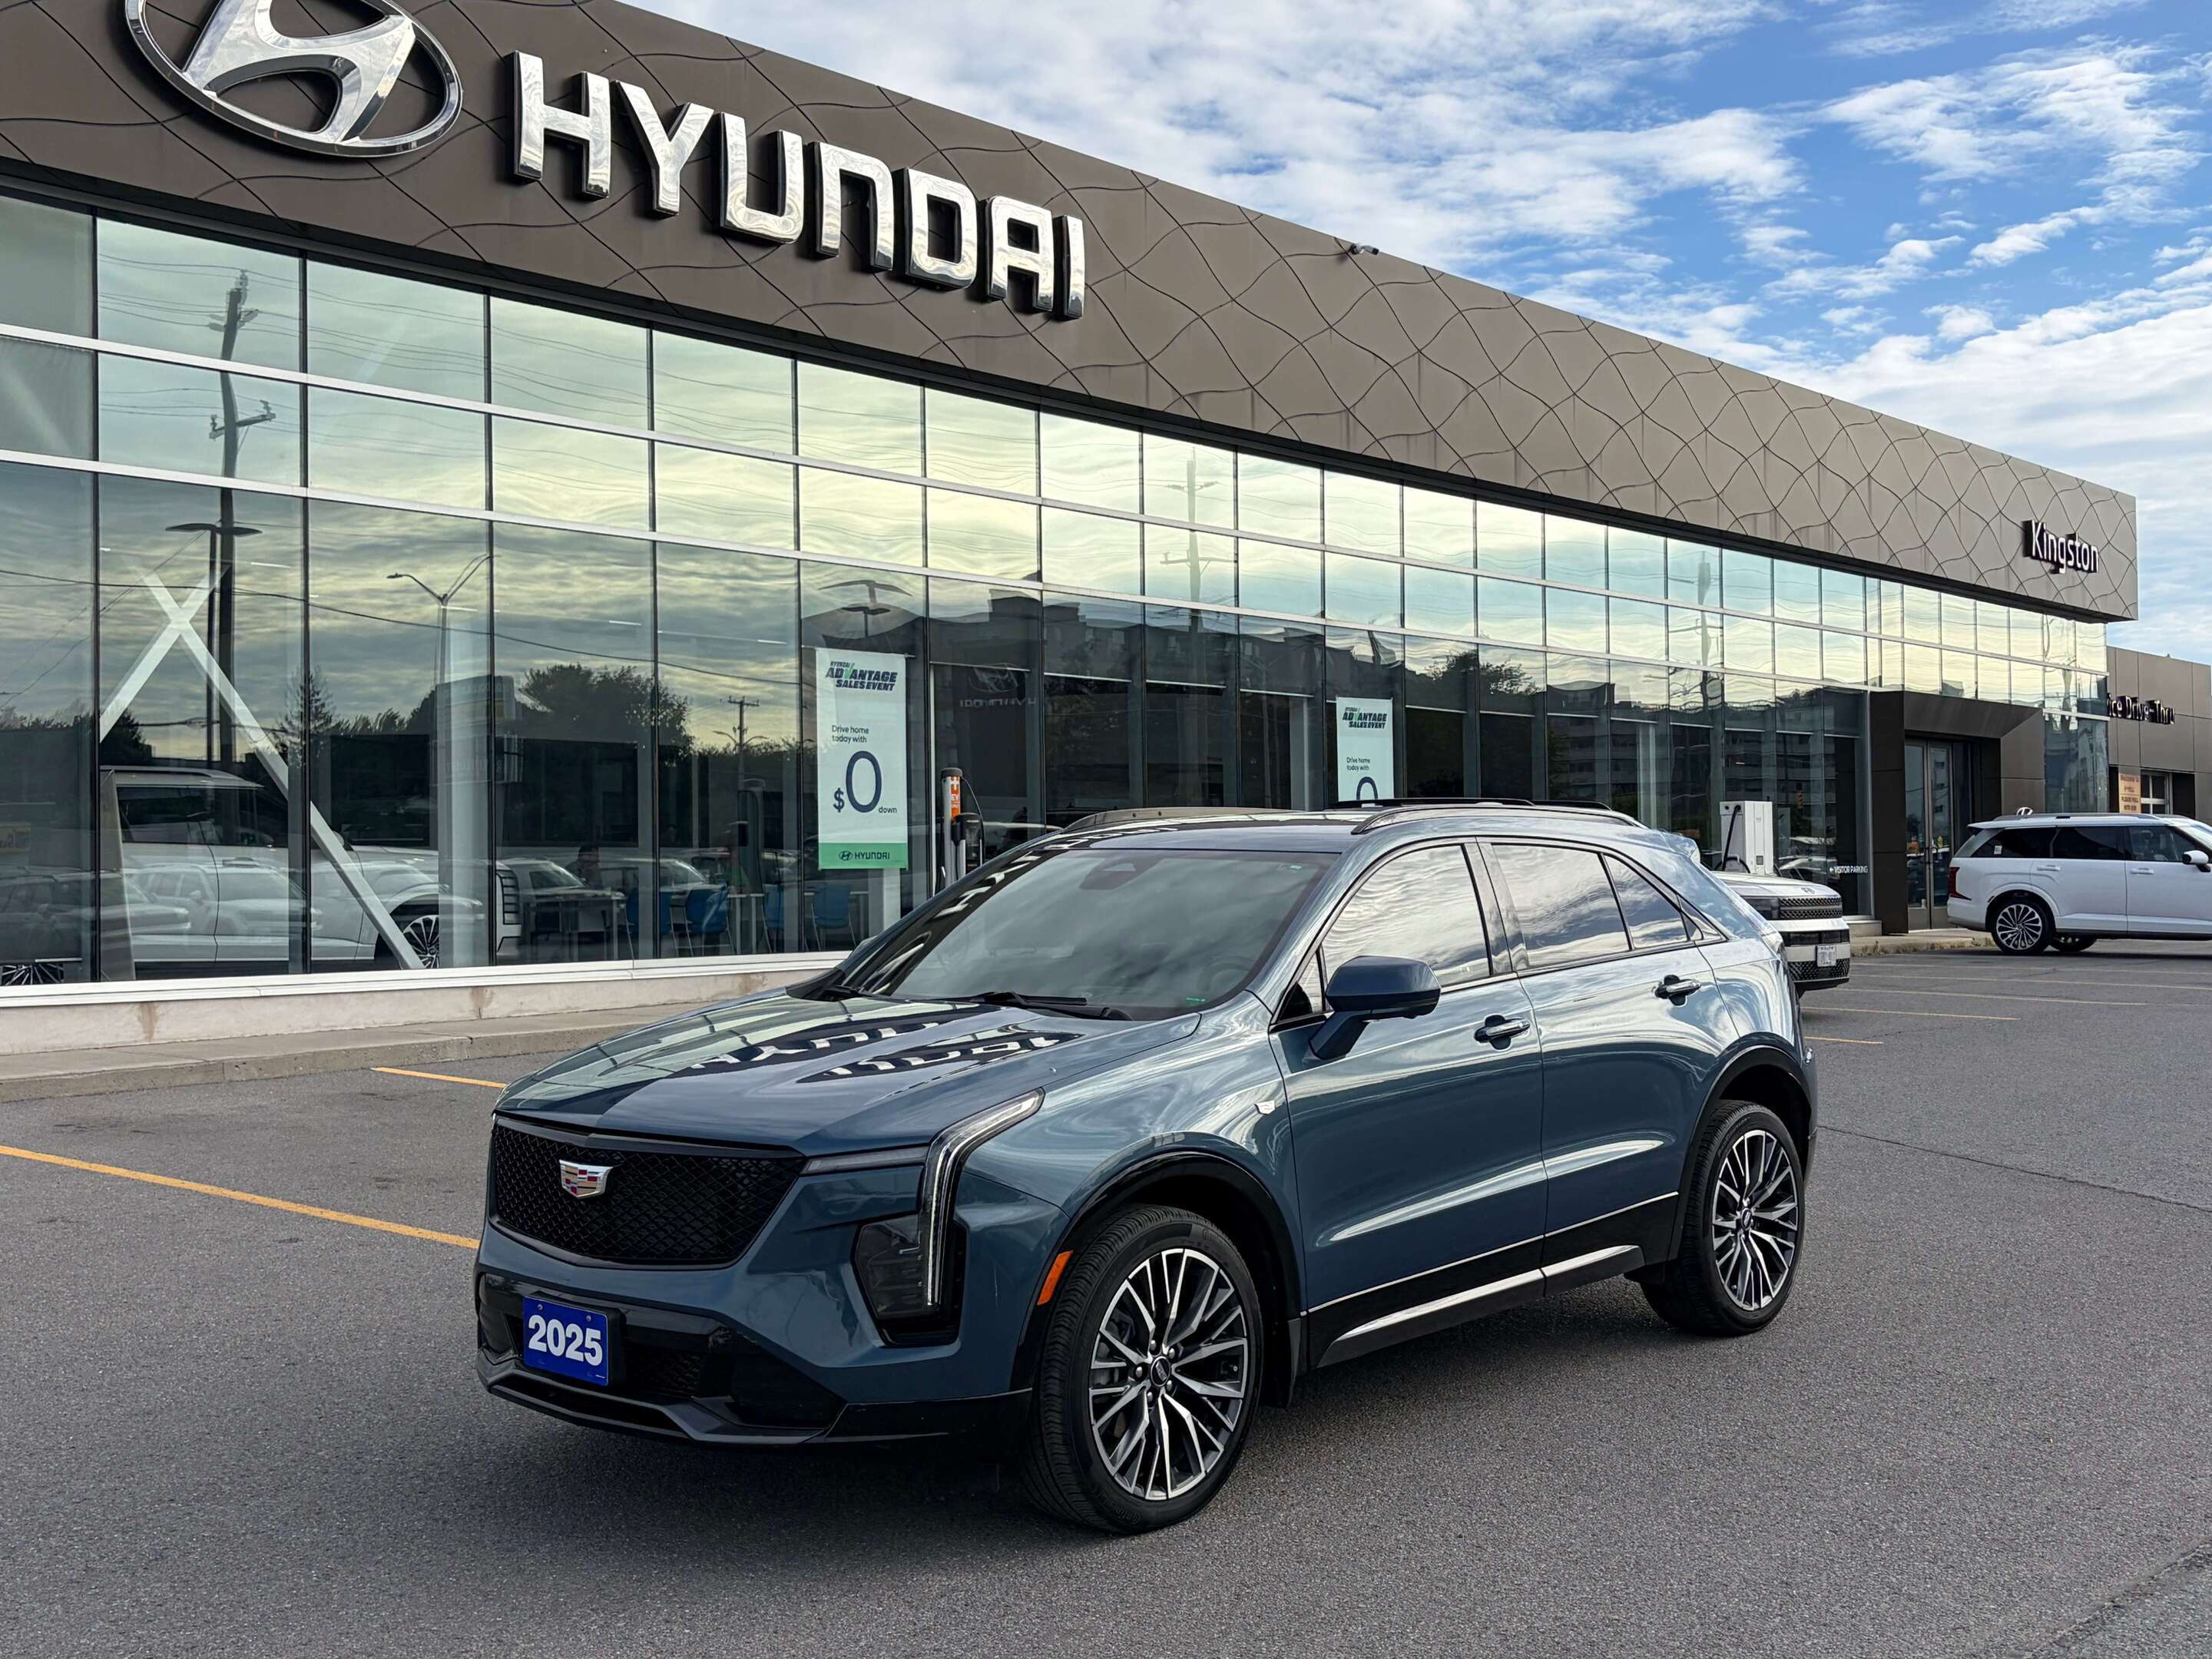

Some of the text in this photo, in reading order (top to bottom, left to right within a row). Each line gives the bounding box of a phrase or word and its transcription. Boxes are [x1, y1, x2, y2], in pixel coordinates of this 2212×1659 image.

[507, 50, 1085, 320] HYUNDAI
[2030, 519, 2099, 574] Kingston
[825, 664, 898, 683] ADVANTAGE
[836, 679, 896, 691] SALES EVENT
[2125, 695, 2176, 725] Drive-Thru
[1343, 712, 1387, 722] ADVANTAGE
[849, 726, 869, 734] home
[832, 734, 852, 744] today
[878, 806, 897, 814] down
[854, 851, 891, 860] HYUNDAI
[528, 1314, 603, 1366] 2025
